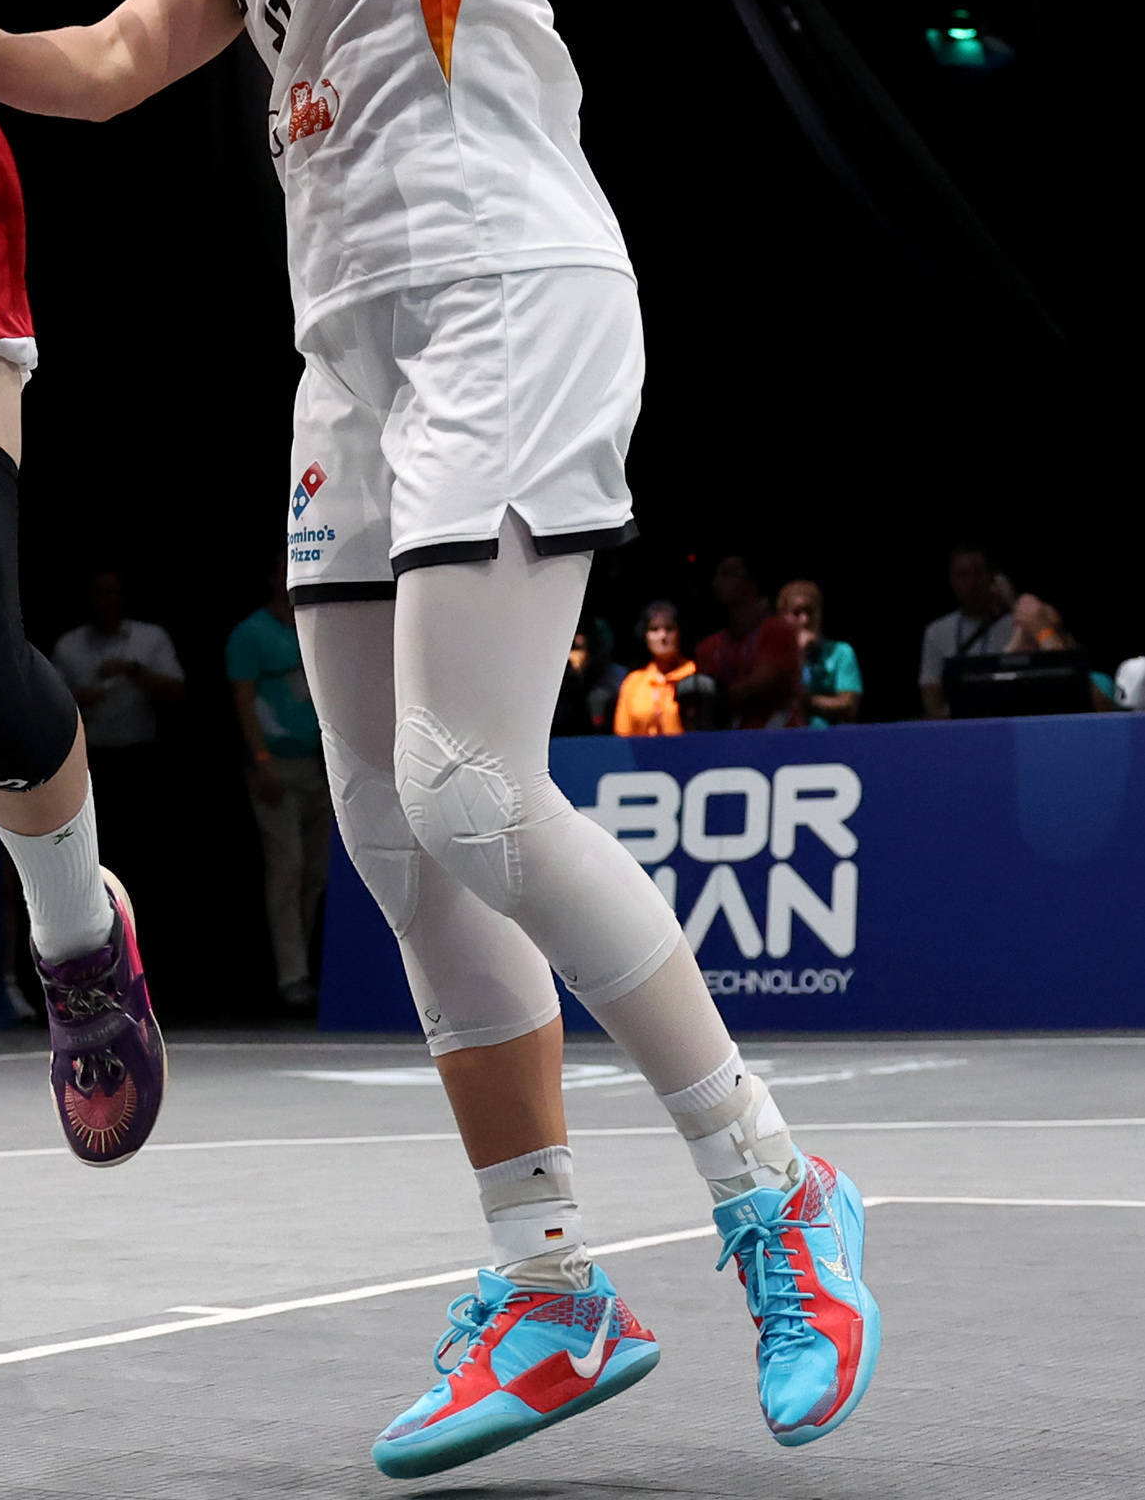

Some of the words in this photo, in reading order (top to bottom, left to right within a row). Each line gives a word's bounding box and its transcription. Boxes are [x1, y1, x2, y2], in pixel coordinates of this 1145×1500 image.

[596, 763, 862, 864] BOR
[652, 860, 858, 959] AN
[701, 968, 855, 995] ECHNOLOGY
